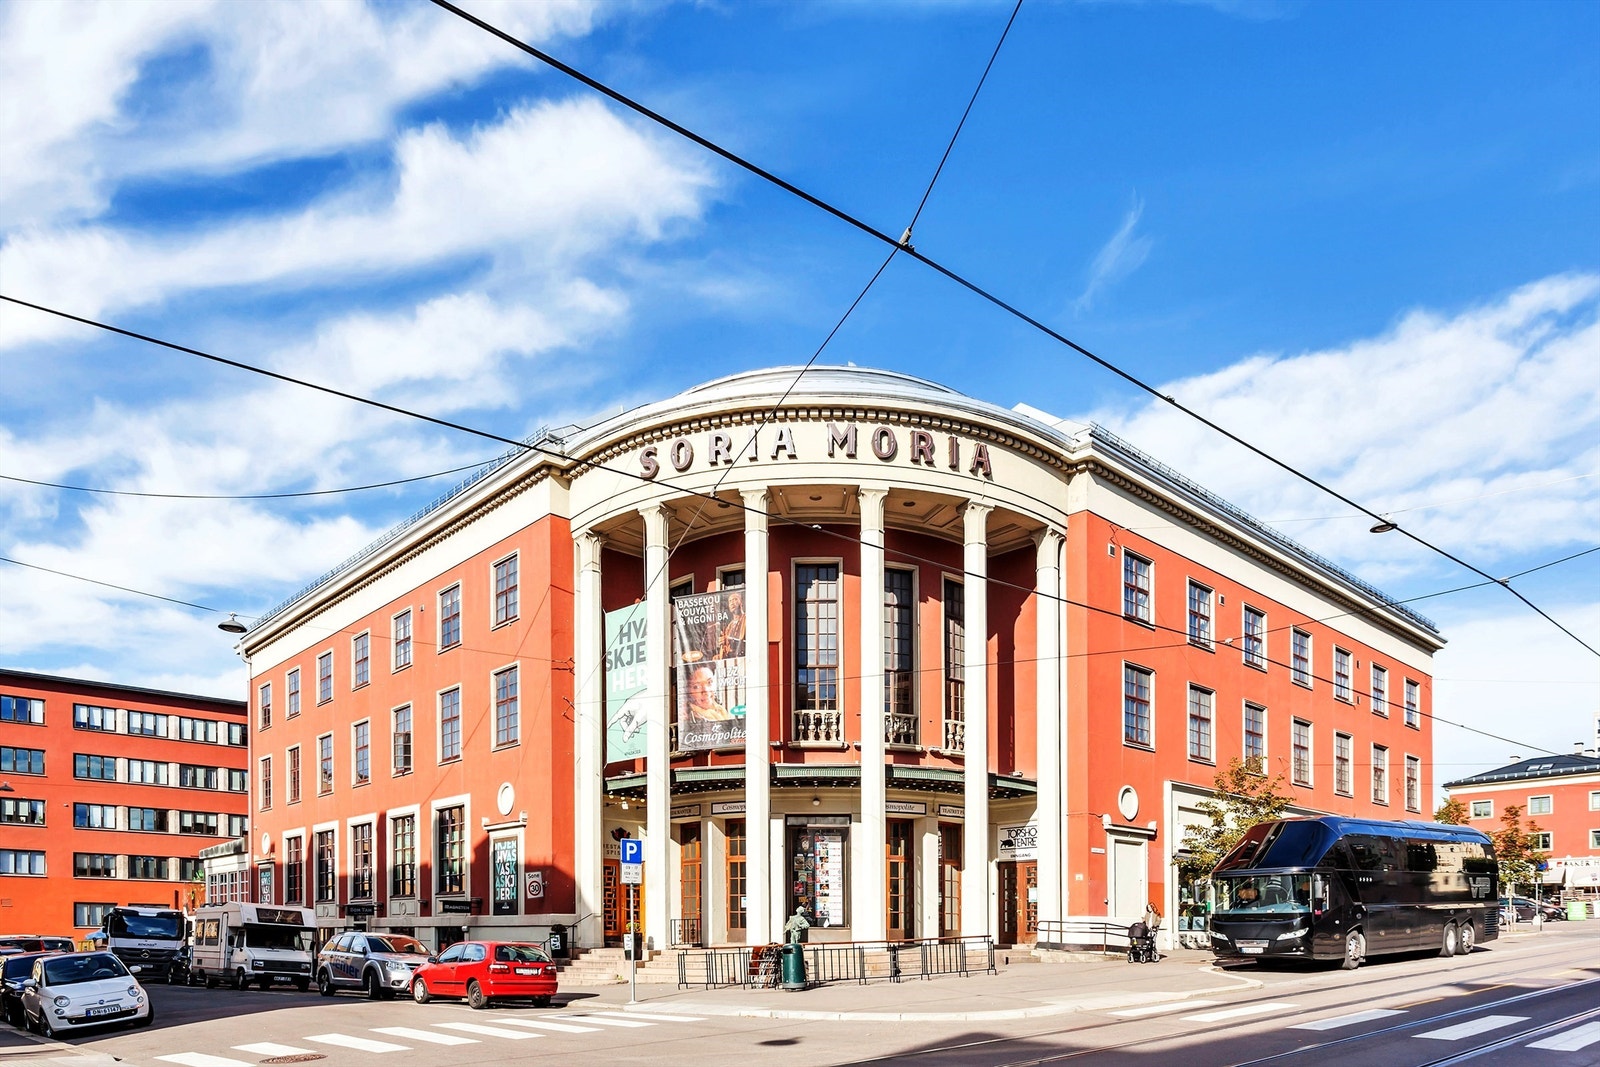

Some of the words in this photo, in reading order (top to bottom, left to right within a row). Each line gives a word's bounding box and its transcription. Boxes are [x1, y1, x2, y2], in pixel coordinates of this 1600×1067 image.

[639, 424, 798, 481] SORIA
[827, 422, 993, 480] MORIA
[678, 595, 720, 609] BASSEKOU
[679, 605, 715, 617] KOUYATE
[687, 614, 715, 625] NGONI
[717, 611, 729, 621] BA
[684, 726, 746, 745] Cosmopolite
[1007, 827, 1038, 839] TORSHO
[626, 842, 637, 861] P
[530, 884, 539, 893] 30
[1469, 877, 1490, 898] VIP
